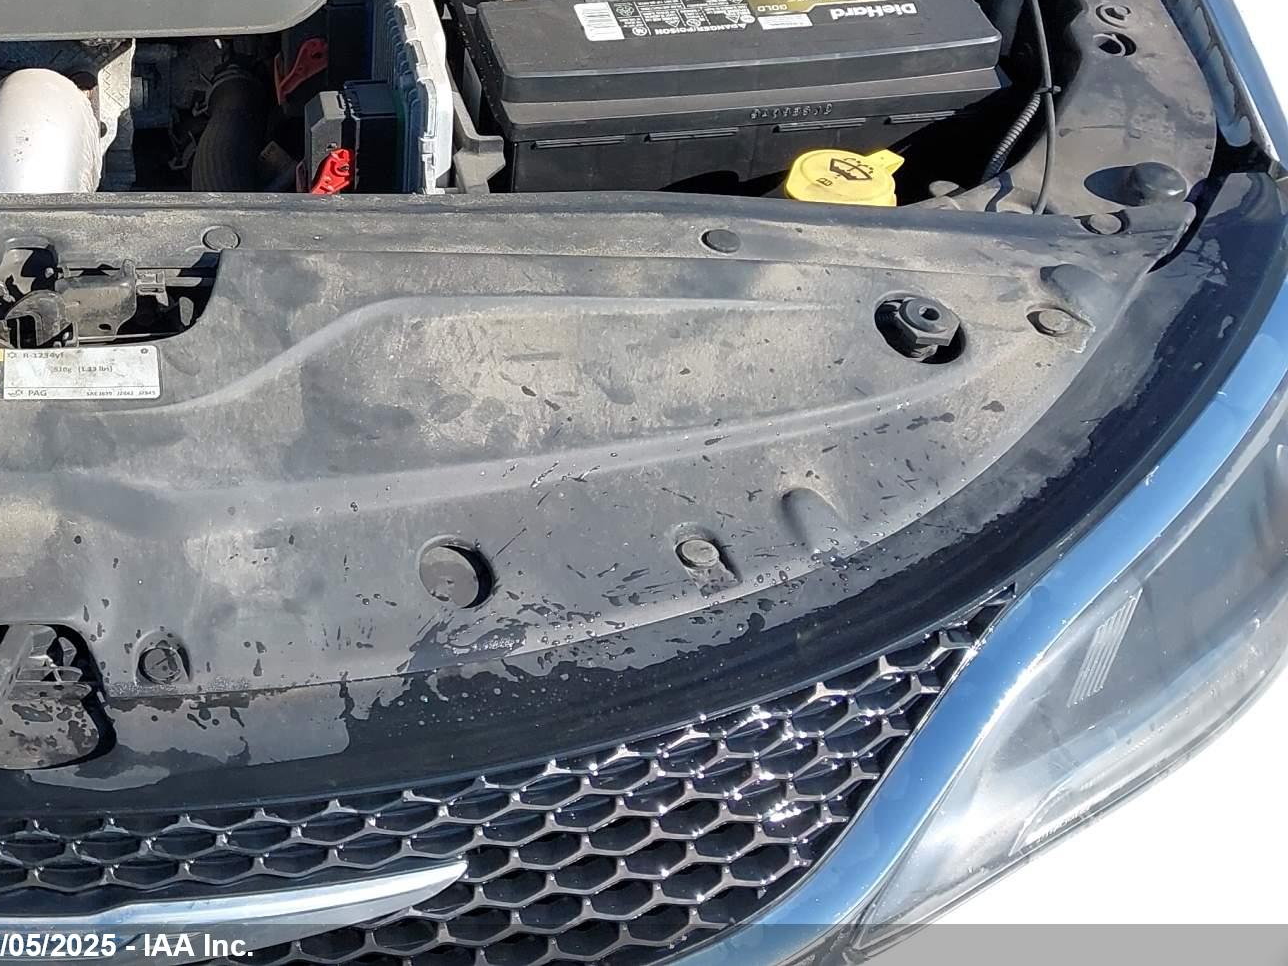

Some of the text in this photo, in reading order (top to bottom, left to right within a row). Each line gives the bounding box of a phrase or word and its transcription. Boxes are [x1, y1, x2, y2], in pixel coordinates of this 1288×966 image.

[757, 4, 788, 12] GOLD
[829, 1, 918, 21] DieHard
[28, 388, 47, 398] PAG
